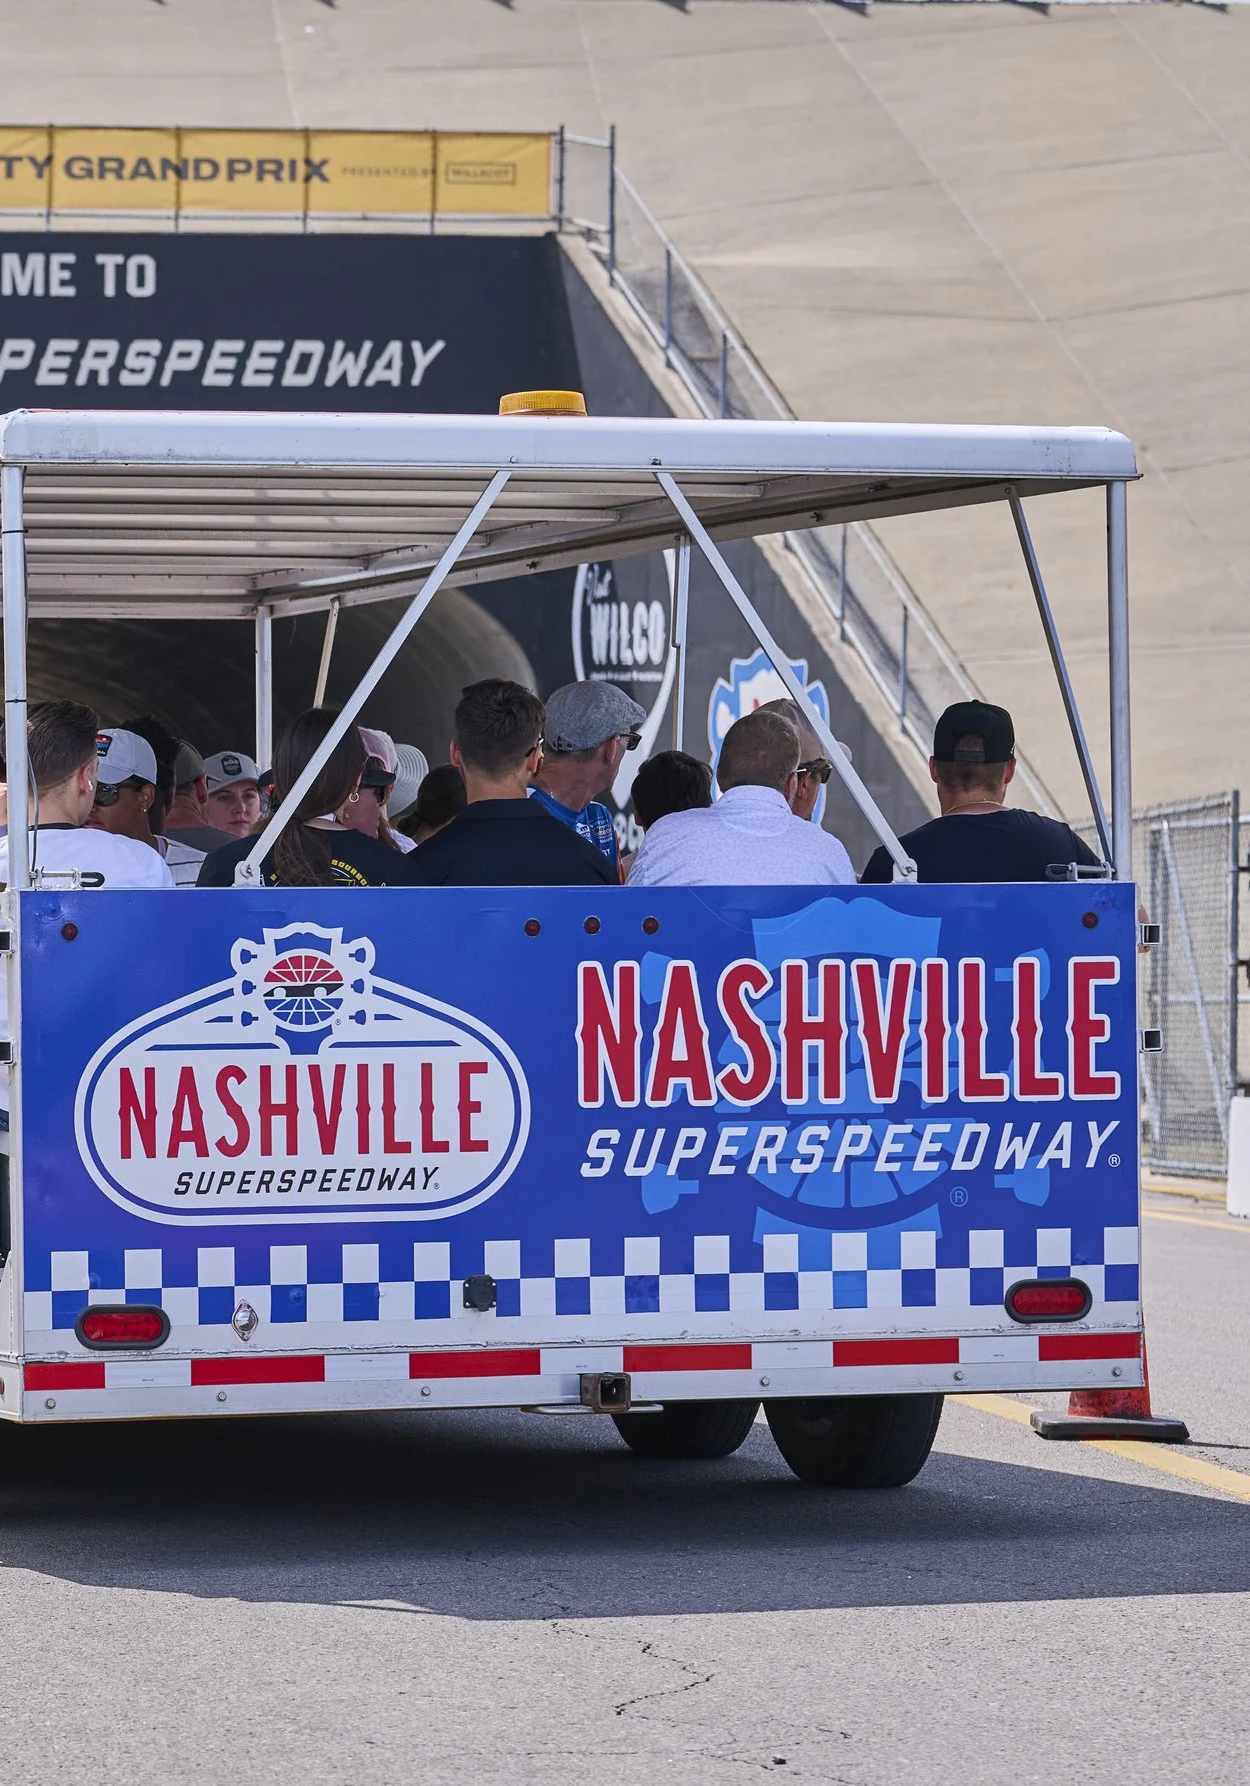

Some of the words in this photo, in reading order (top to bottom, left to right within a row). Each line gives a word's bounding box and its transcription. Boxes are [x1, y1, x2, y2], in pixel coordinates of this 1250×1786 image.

[63, 155, 220, 181] GRAND
[225, 157, 330, 183] PRIX
[95, 253, 156, 298] TO
[590, 599, 666, 666] WILCO
[331, 858, 369, 887] BOURBO
[575, 955, 1121, 1108] NASHVILLE
[118, 1061, 489, 1159] NASHVILLE
[580, 1120, 1121, 1178] SUPERSPEEDWAY
[173, 1166, 440, 1195] SUPERSPEEDWAY
